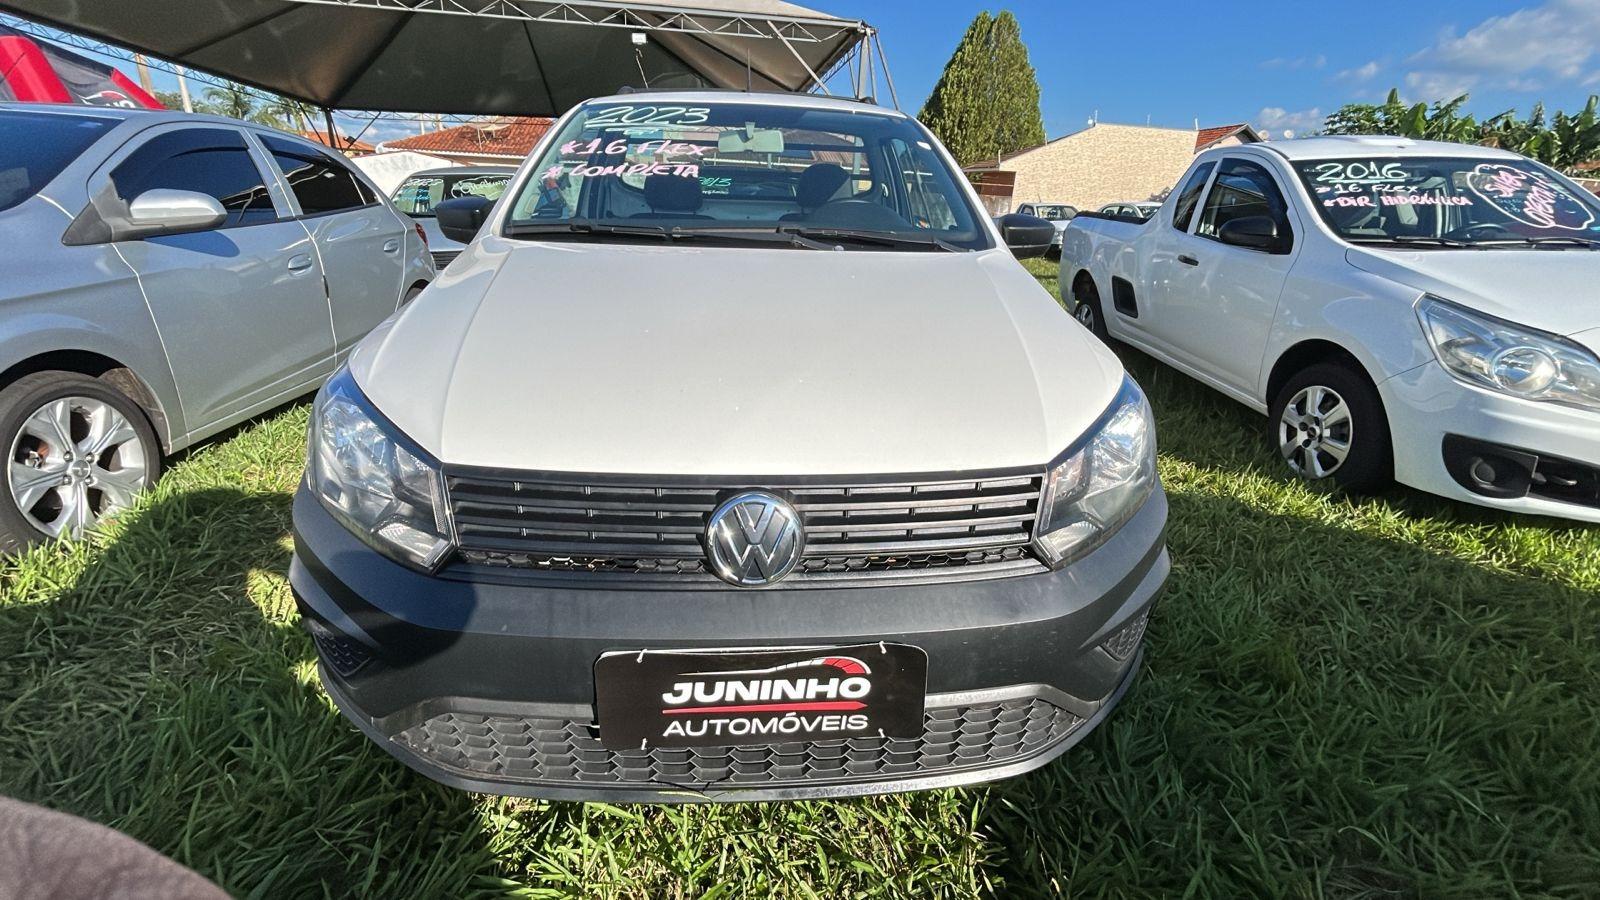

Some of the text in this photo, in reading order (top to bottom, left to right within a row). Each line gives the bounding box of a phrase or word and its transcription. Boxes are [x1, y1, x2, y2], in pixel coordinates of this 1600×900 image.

[583, 106, 711, 125] 2023
[1315, 161, 1408, 182] 2016
[661, 676, 872, 705] JUNINHO
[662, 711, 869, 738] AUTOMÓVEIS
